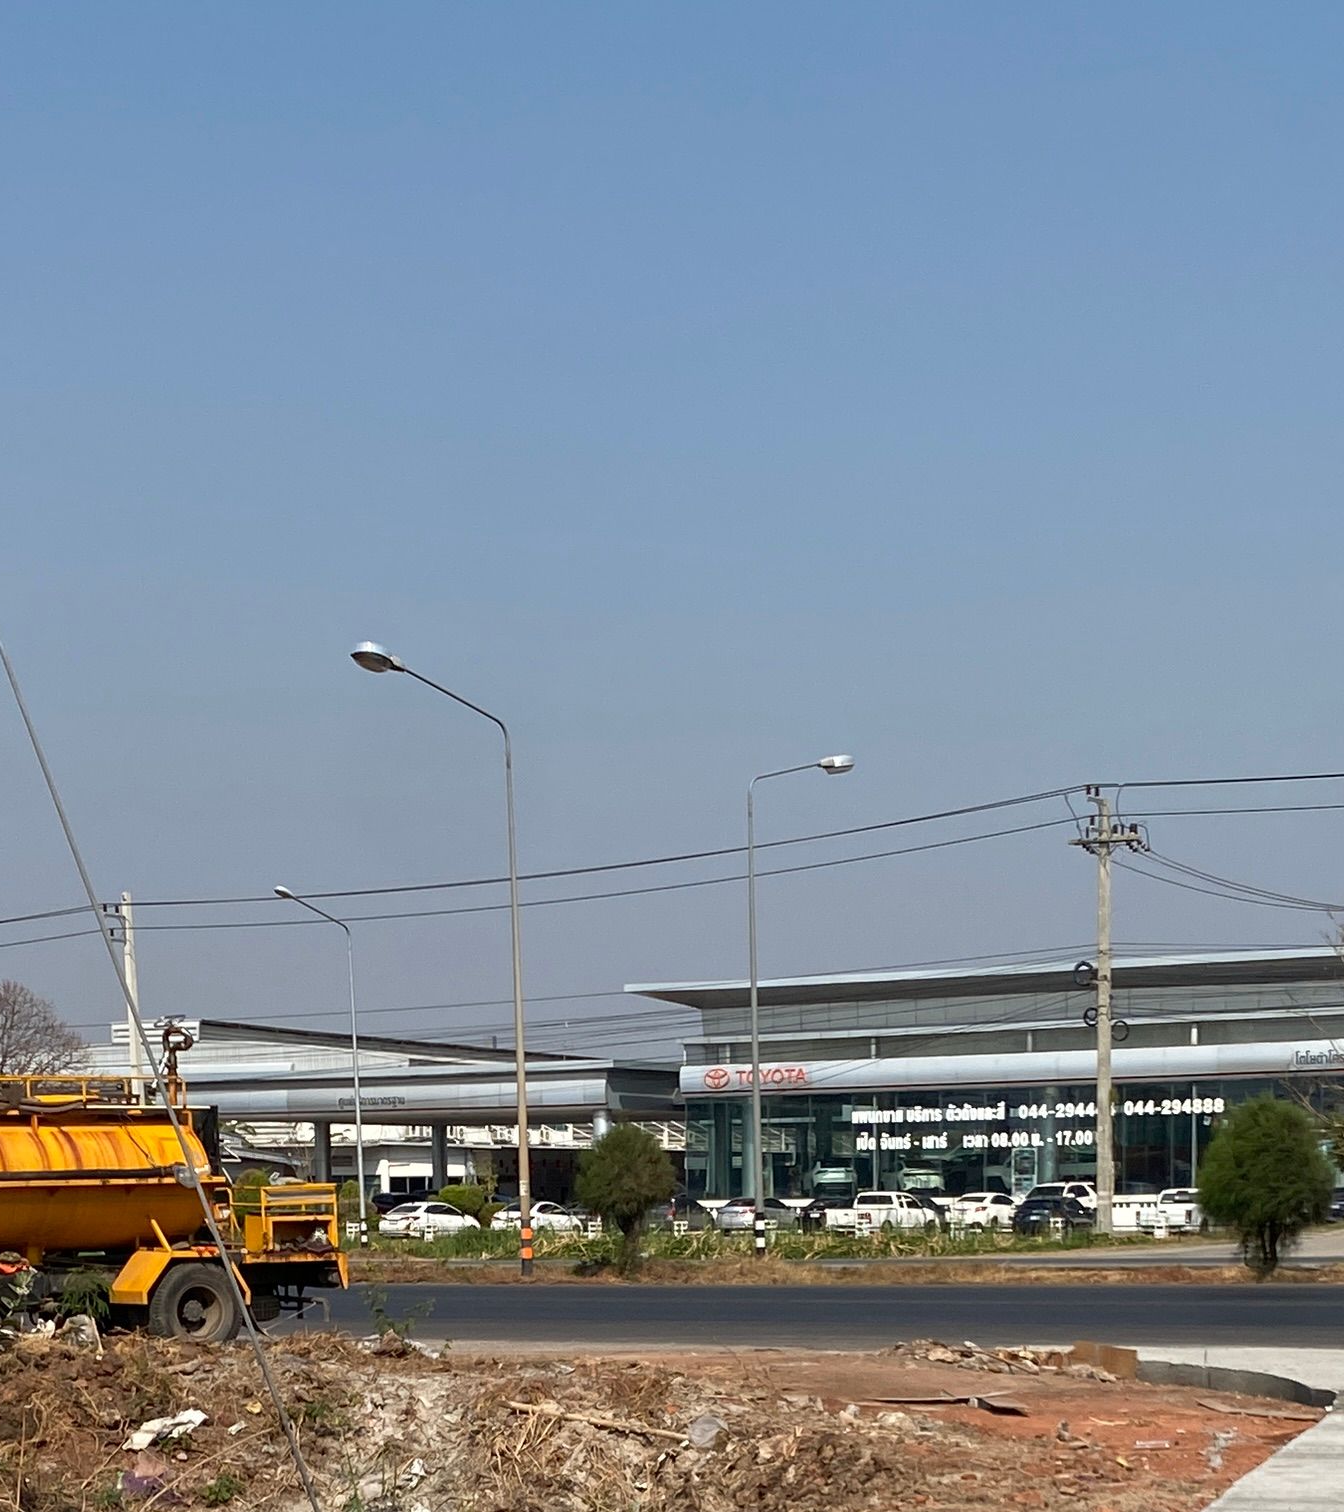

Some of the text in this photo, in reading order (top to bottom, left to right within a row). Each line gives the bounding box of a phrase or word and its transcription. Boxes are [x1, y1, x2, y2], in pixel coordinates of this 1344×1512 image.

[906, 1105, 943, 1123] บริการ
[1018, 1102, 1117, 1119] 044-2944
[1123, 1098, 1225, 1116] 044-294888
[856, 1131, 877, 1151] เปิด
[879, 1132, 912, 1150] จันทร์
[922, 1131, 948, 1150] เสาร์
[962, 1134, 989, 1149] เวลา
[990, 1131, 1029, 1148] 08.00
[1056, 1130, 1093, 1146] 17.00
